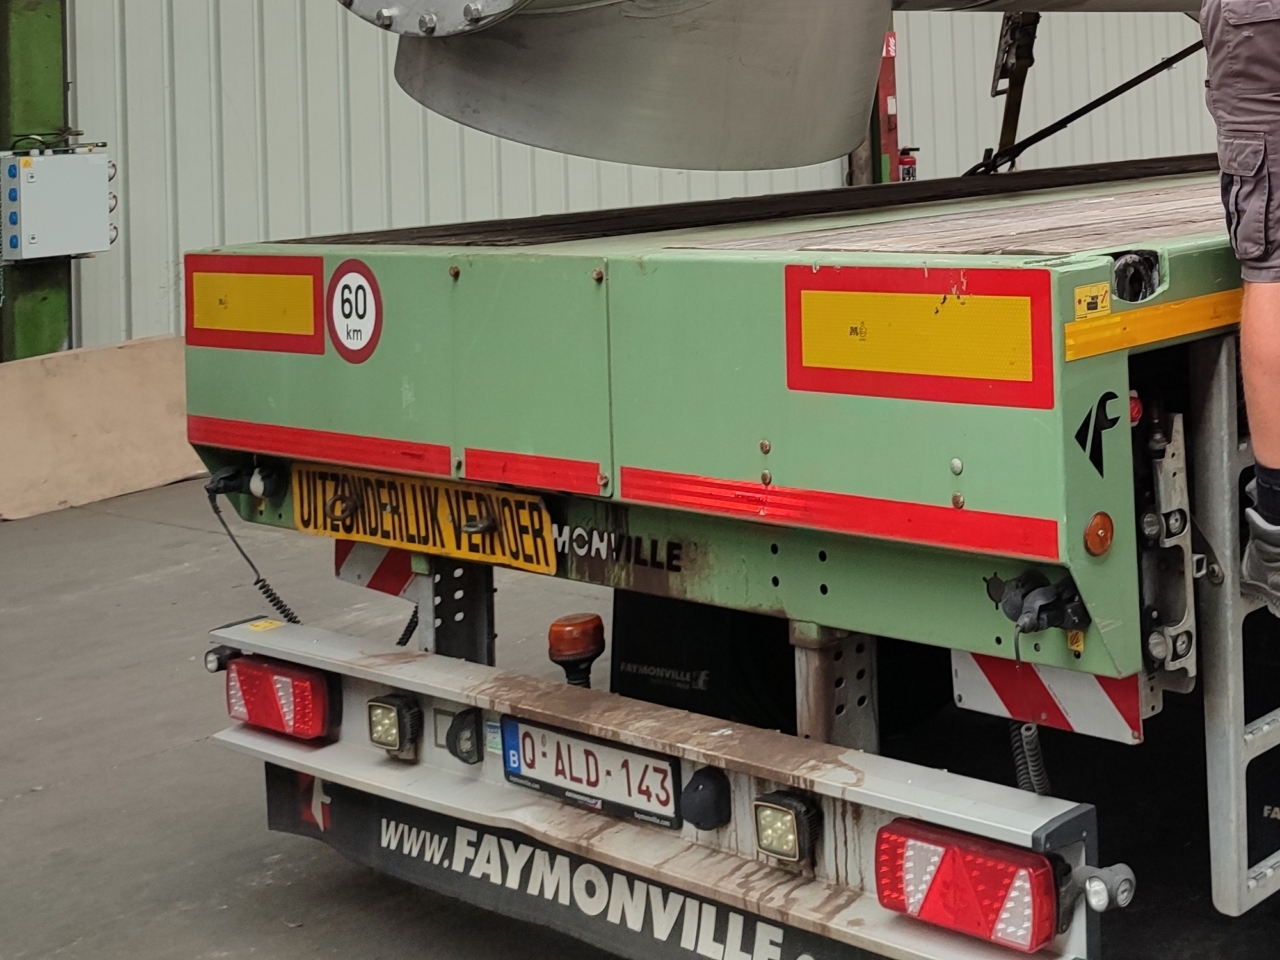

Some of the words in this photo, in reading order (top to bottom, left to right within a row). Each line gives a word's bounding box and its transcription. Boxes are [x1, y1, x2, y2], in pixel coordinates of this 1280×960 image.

[341, 284, 367, 320] 60
[346, 323, 362, 341] km
[298, 469, 445, 548] UITZONDERLIJK
[445, 488, 550, 567] VERVOER
[553, 523, 682, 572] MONVILLE
[620, 662, 692, 681] FAYMONVILLE
[509, 750, 519, 768] B
[521, 730, 671, 807] Q-ALD-143
